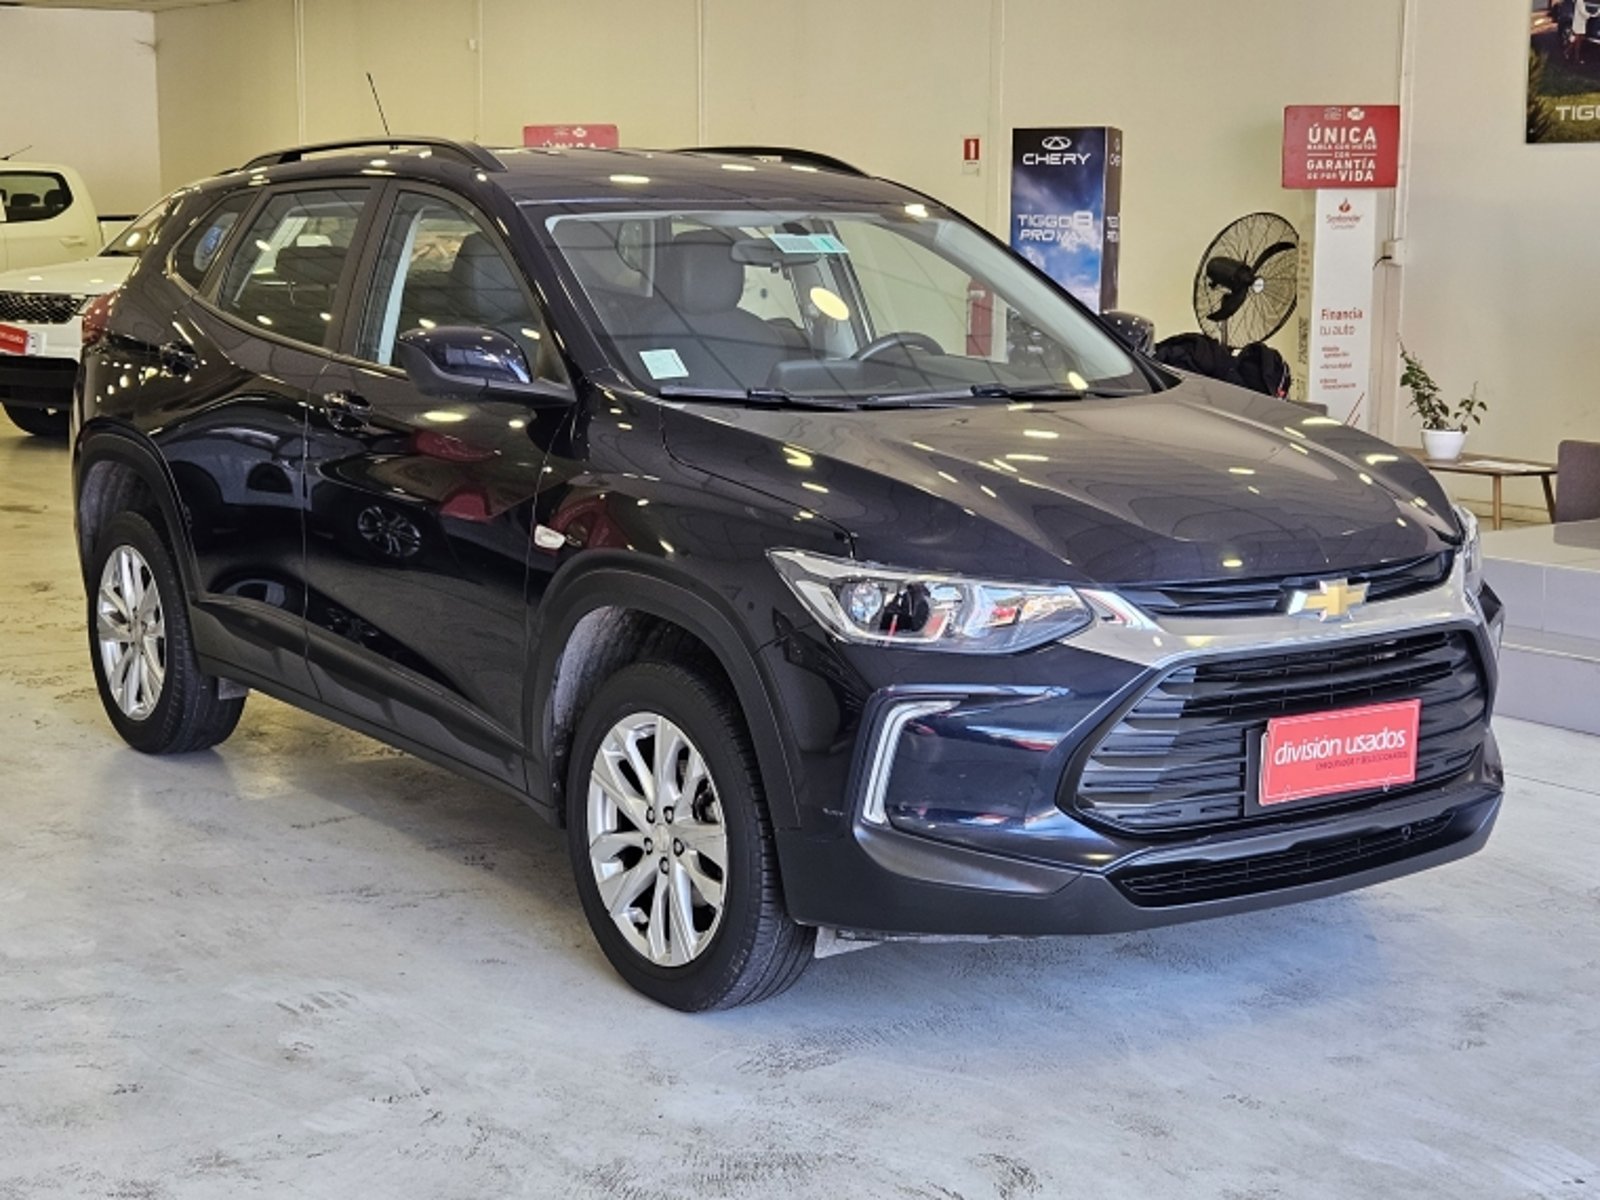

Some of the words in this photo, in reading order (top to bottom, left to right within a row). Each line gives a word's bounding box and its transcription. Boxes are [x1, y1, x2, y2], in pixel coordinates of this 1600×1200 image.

[1555, 104, 1600, 121] TIG
[1308, 122, 1377, 144] ÚNICA
[1022, 152, 1092, 165] CHERY
[1307, 158, 1376, 171] GARANTÍA
[1338, 169, 1375, 182] VIDA
[1321, 307, 1364, 321] Financia
[1274, 734, 1342, 766] división
[1345, 726, 1407, 755] usados
